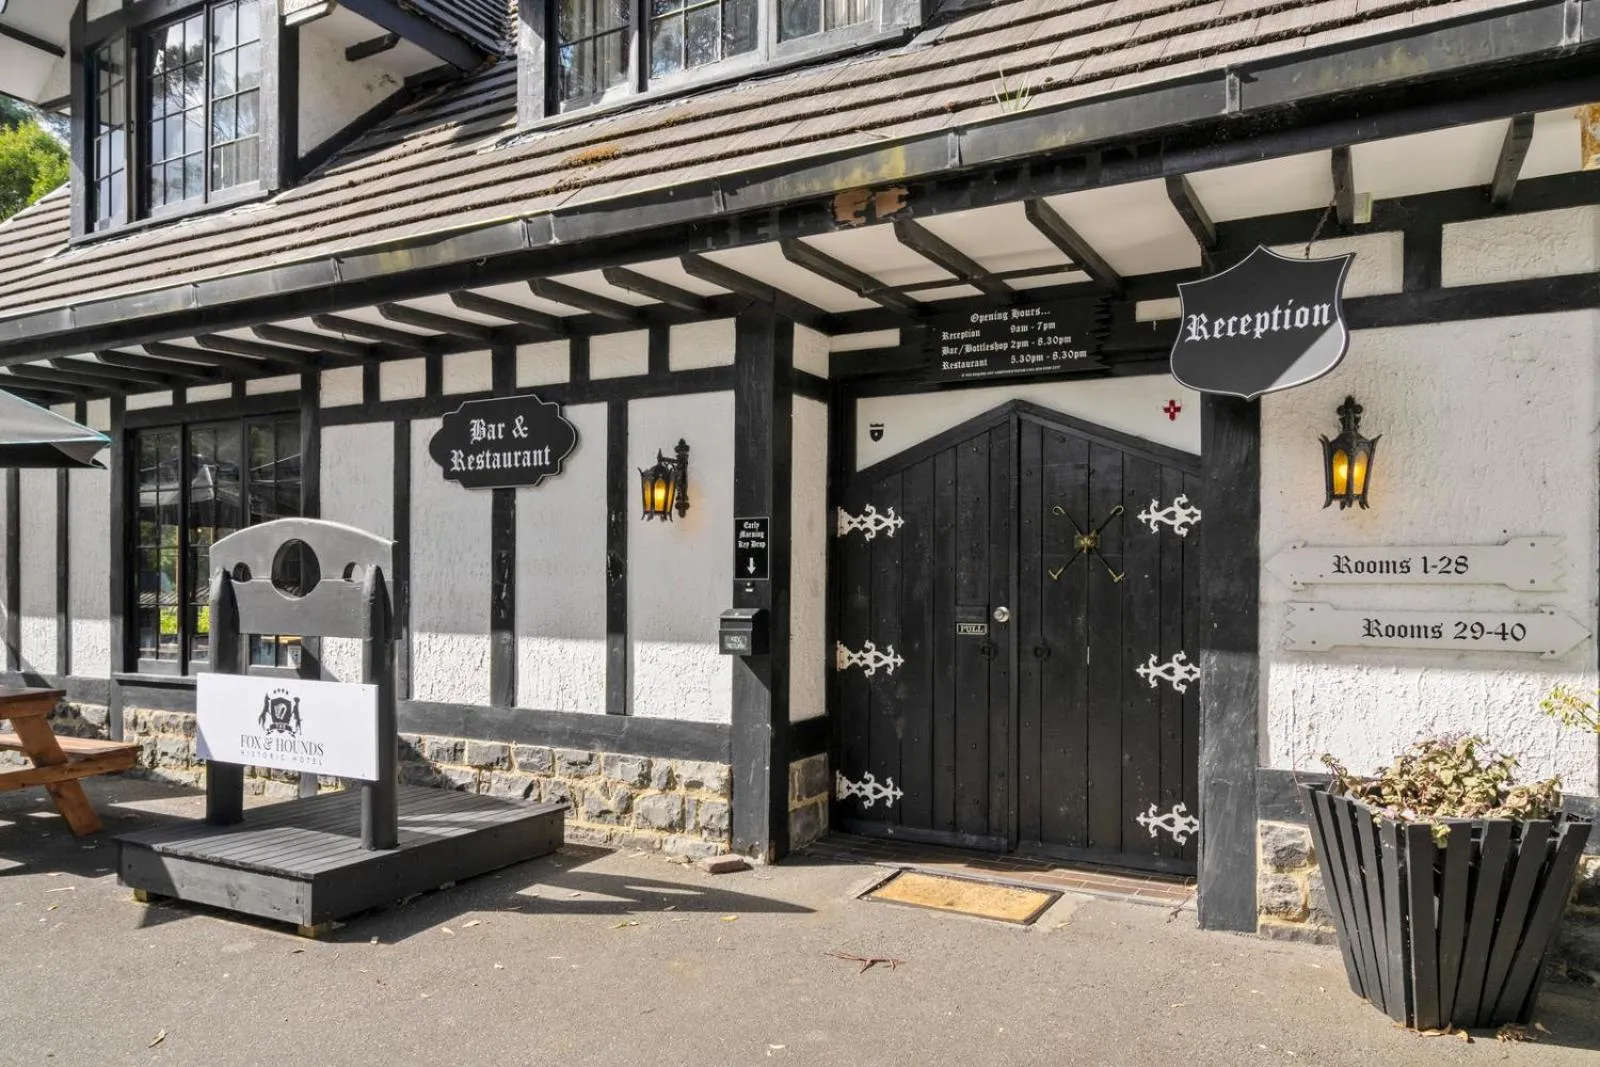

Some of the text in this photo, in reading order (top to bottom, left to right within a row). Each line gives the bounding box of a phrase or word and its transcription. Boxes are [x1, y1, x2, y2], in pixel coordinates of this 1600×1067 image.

[970, 311, 1008, 323] Opening
[1185, 299, 1331, 342] Reception
[941, 329, 981, 341] Reception
[1010, 325, 1028, 333] 9am
[1037, 321, 1056, 331] 7pm
[1010, 340, 1029, 349] 2pm
[942, 358, 988, 370] Restaurant
[1010, 354, 1044, 364] 5.30pm
[469, 415, 529, 444] Bar &
[450, 445, 551, 472] Restaurant
[1332, 555, 1469, 574] Rooms 1-28
[1361, 618, 1527, 642] Rooms 29-40
[241, 734, 324, 757] FOX & HOUNDS
